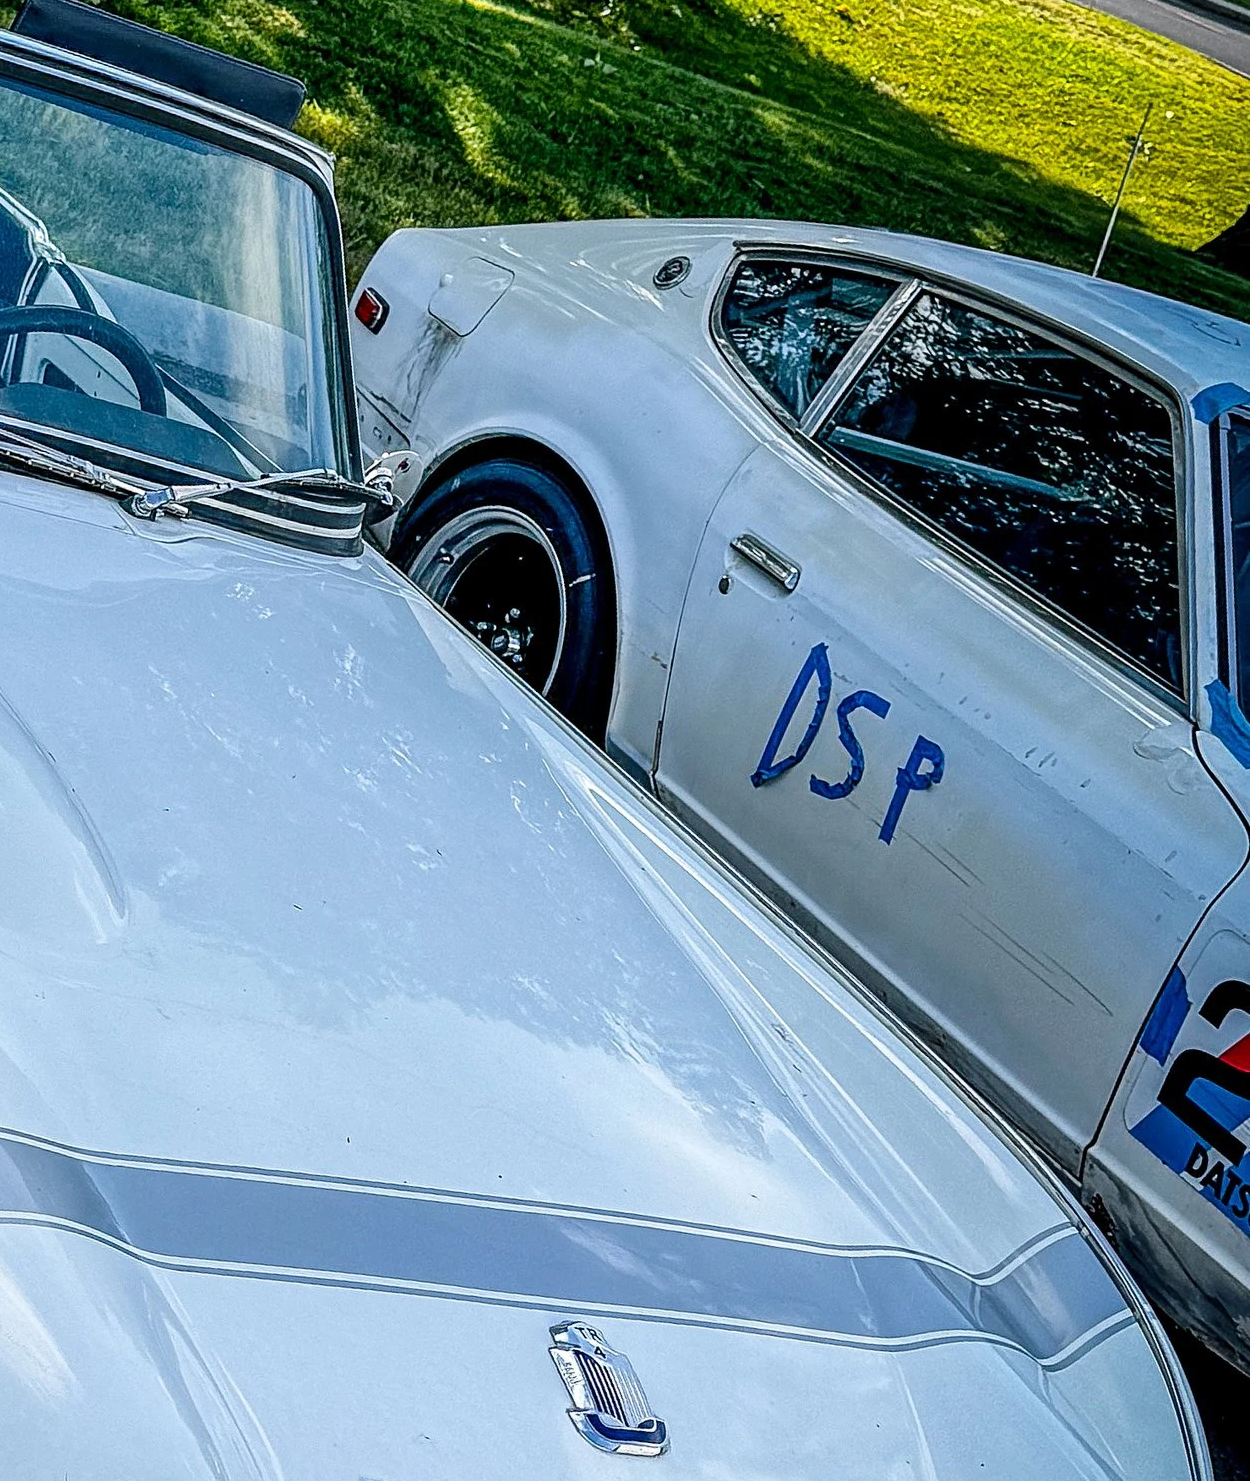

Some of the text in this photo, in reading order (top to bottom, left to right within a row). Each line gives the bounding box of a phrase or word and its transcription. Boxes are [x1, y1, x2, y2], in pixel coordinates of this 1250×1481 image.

[750, 642, 945, 846] DSP
[1184, 1141, 1250, 1224] DATS
[574, 1326, 603, 1342] TR
[593, 1346, 607, 1359] 4
